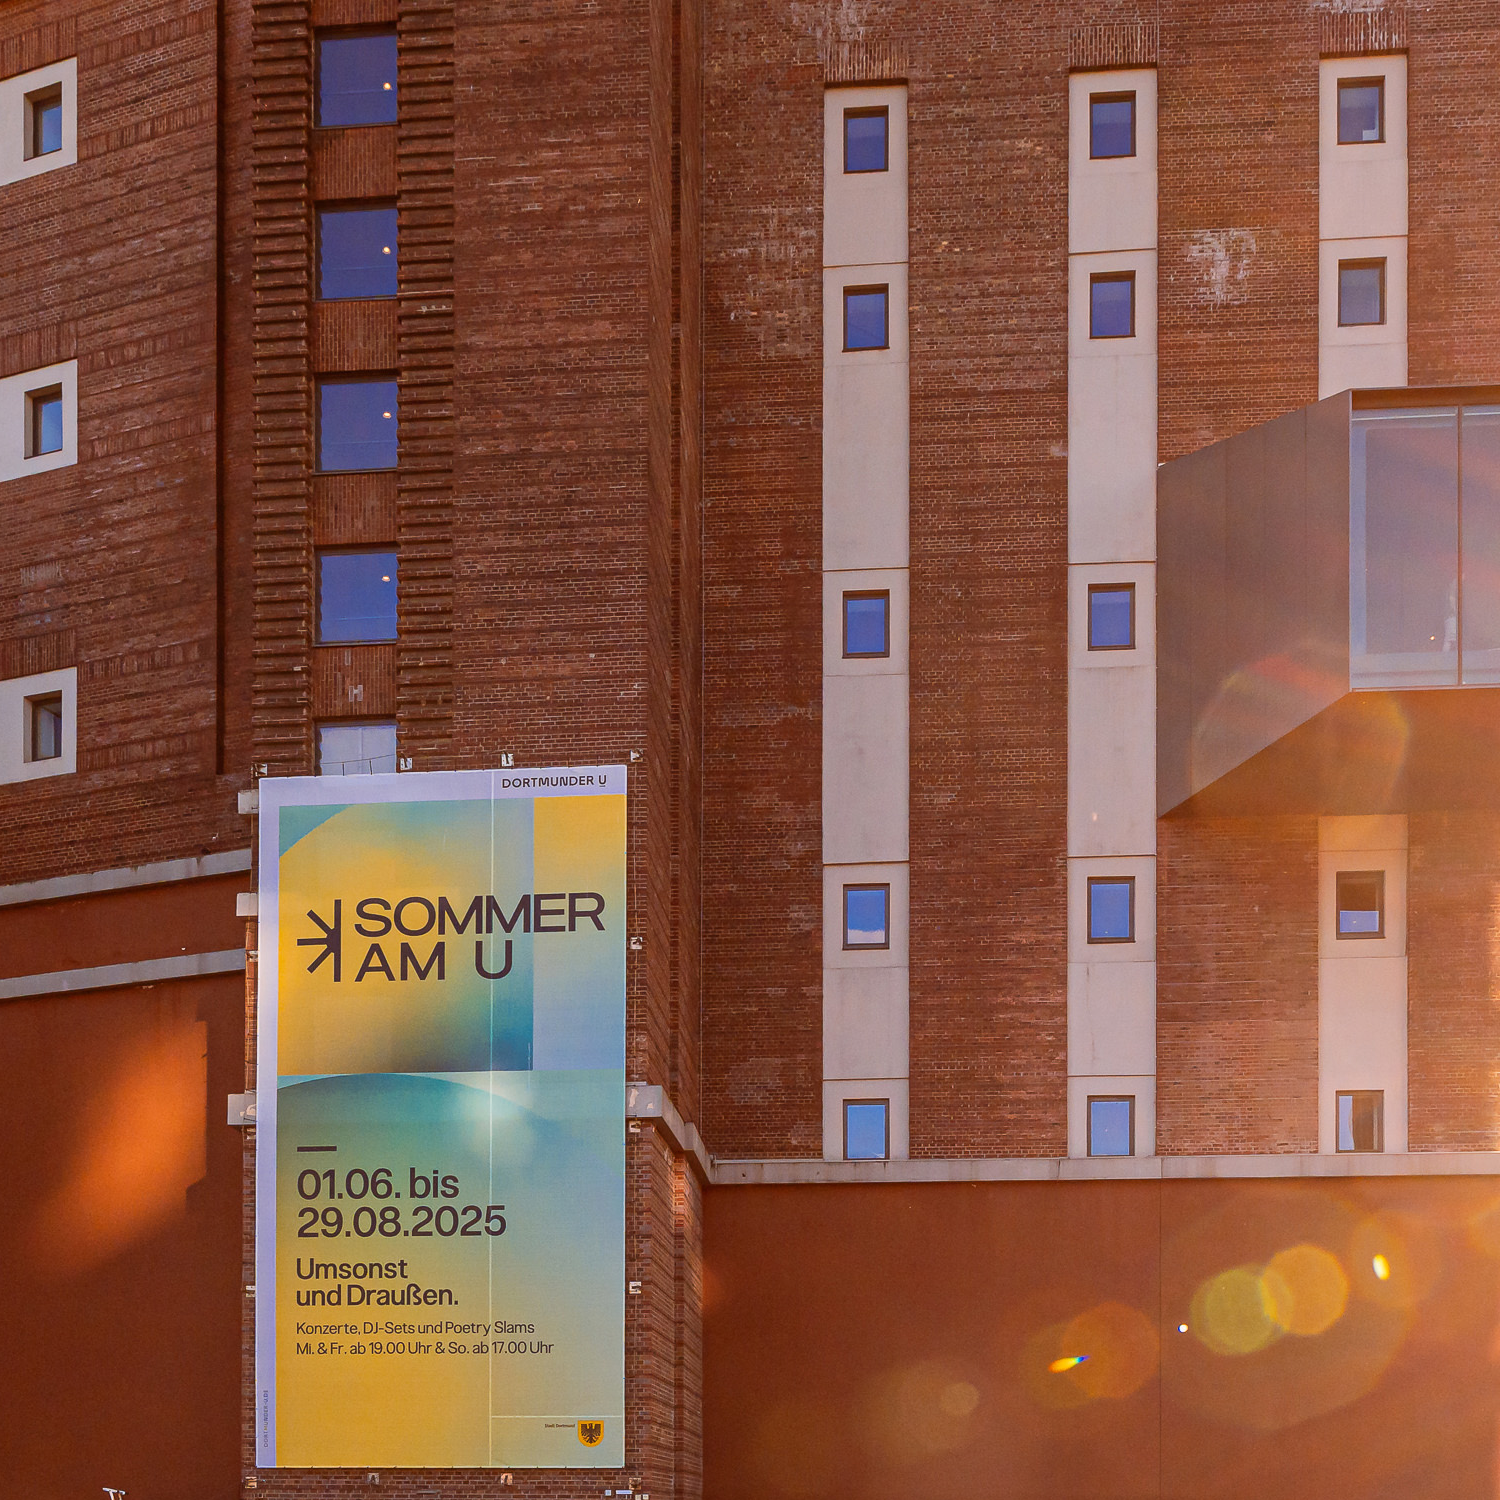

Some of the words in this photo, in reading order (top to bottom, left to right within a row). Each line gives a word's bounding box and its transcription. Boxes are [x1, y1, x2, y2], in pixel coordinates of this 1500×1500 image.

[501, 776, 594, 789] DORTMUNDER
[598, 774, 607, 787] U
[354, 892, 606, 937] SOMMER
[354, 942, 446, 982] AM
[474, 939, 513, 980] U
[297, 1169, 401, 1200] 01.06.
[408, 1168, 460, 1199] bis
[297, 1205, 507, 1238] 29.08.2025
[296, 1258, 409, 1280] Umsonst
[296, 1284, 342, 1307] und
[347, 1283, 459, 1307] Draußen.
[296, 1322, 360, 1336] Konzerte,
[363, 1321, 415, 1335] DJ-Sets
[417, 1321, 443, 1335] und
[445, 1321, 491, 1337] Poetry
[494, 1320, 535, 1334] Slams
[296, 1342, 315, 1355] Mi.
[317, 1342, 328, 1354] &
[330, 1342, 348, 1355] Fr.
[349, 1342, 367, 1355] ab
[368, 1341, 406, 1355] 19.00
[407, 1341, 432, 1354] Uhr
[434, 1341, 446, 1354] &
[447, 1341, 470, 1354] So.
[472, 1341, 490, 1354] ab
[491, 1341, 527, 1354] 17.00
[529, 1341, 555, 1354] Uhr
